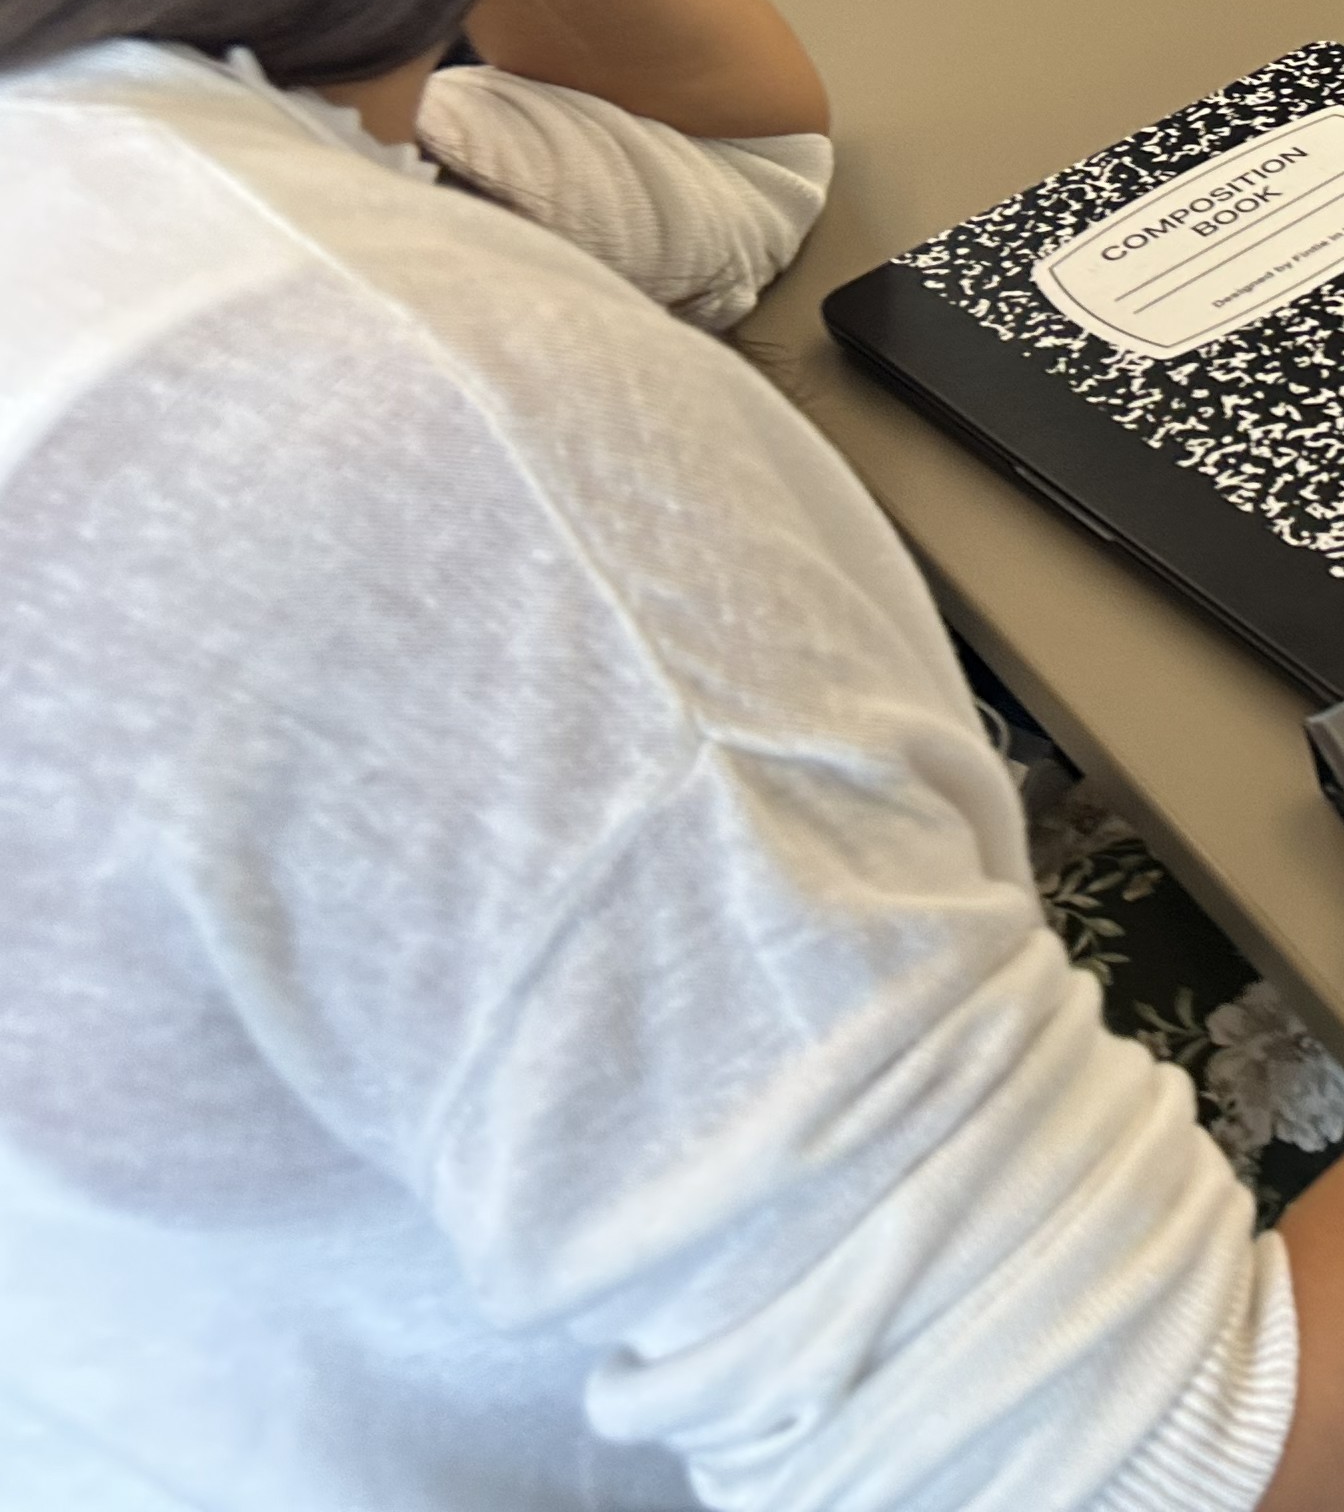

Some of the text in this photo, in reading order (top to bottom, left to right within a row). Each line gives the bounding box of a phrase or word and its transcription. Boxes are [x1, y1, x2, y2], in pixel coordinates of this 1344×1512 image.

[1100, 146, 1310, 262] COMPOSITION
[1190, 185, 1283, 238] BOOK
[1212, 271, 1275, 308] Designed
[1273, 261, 1294, 274] by
[1327, 232, 1344, 242] in
